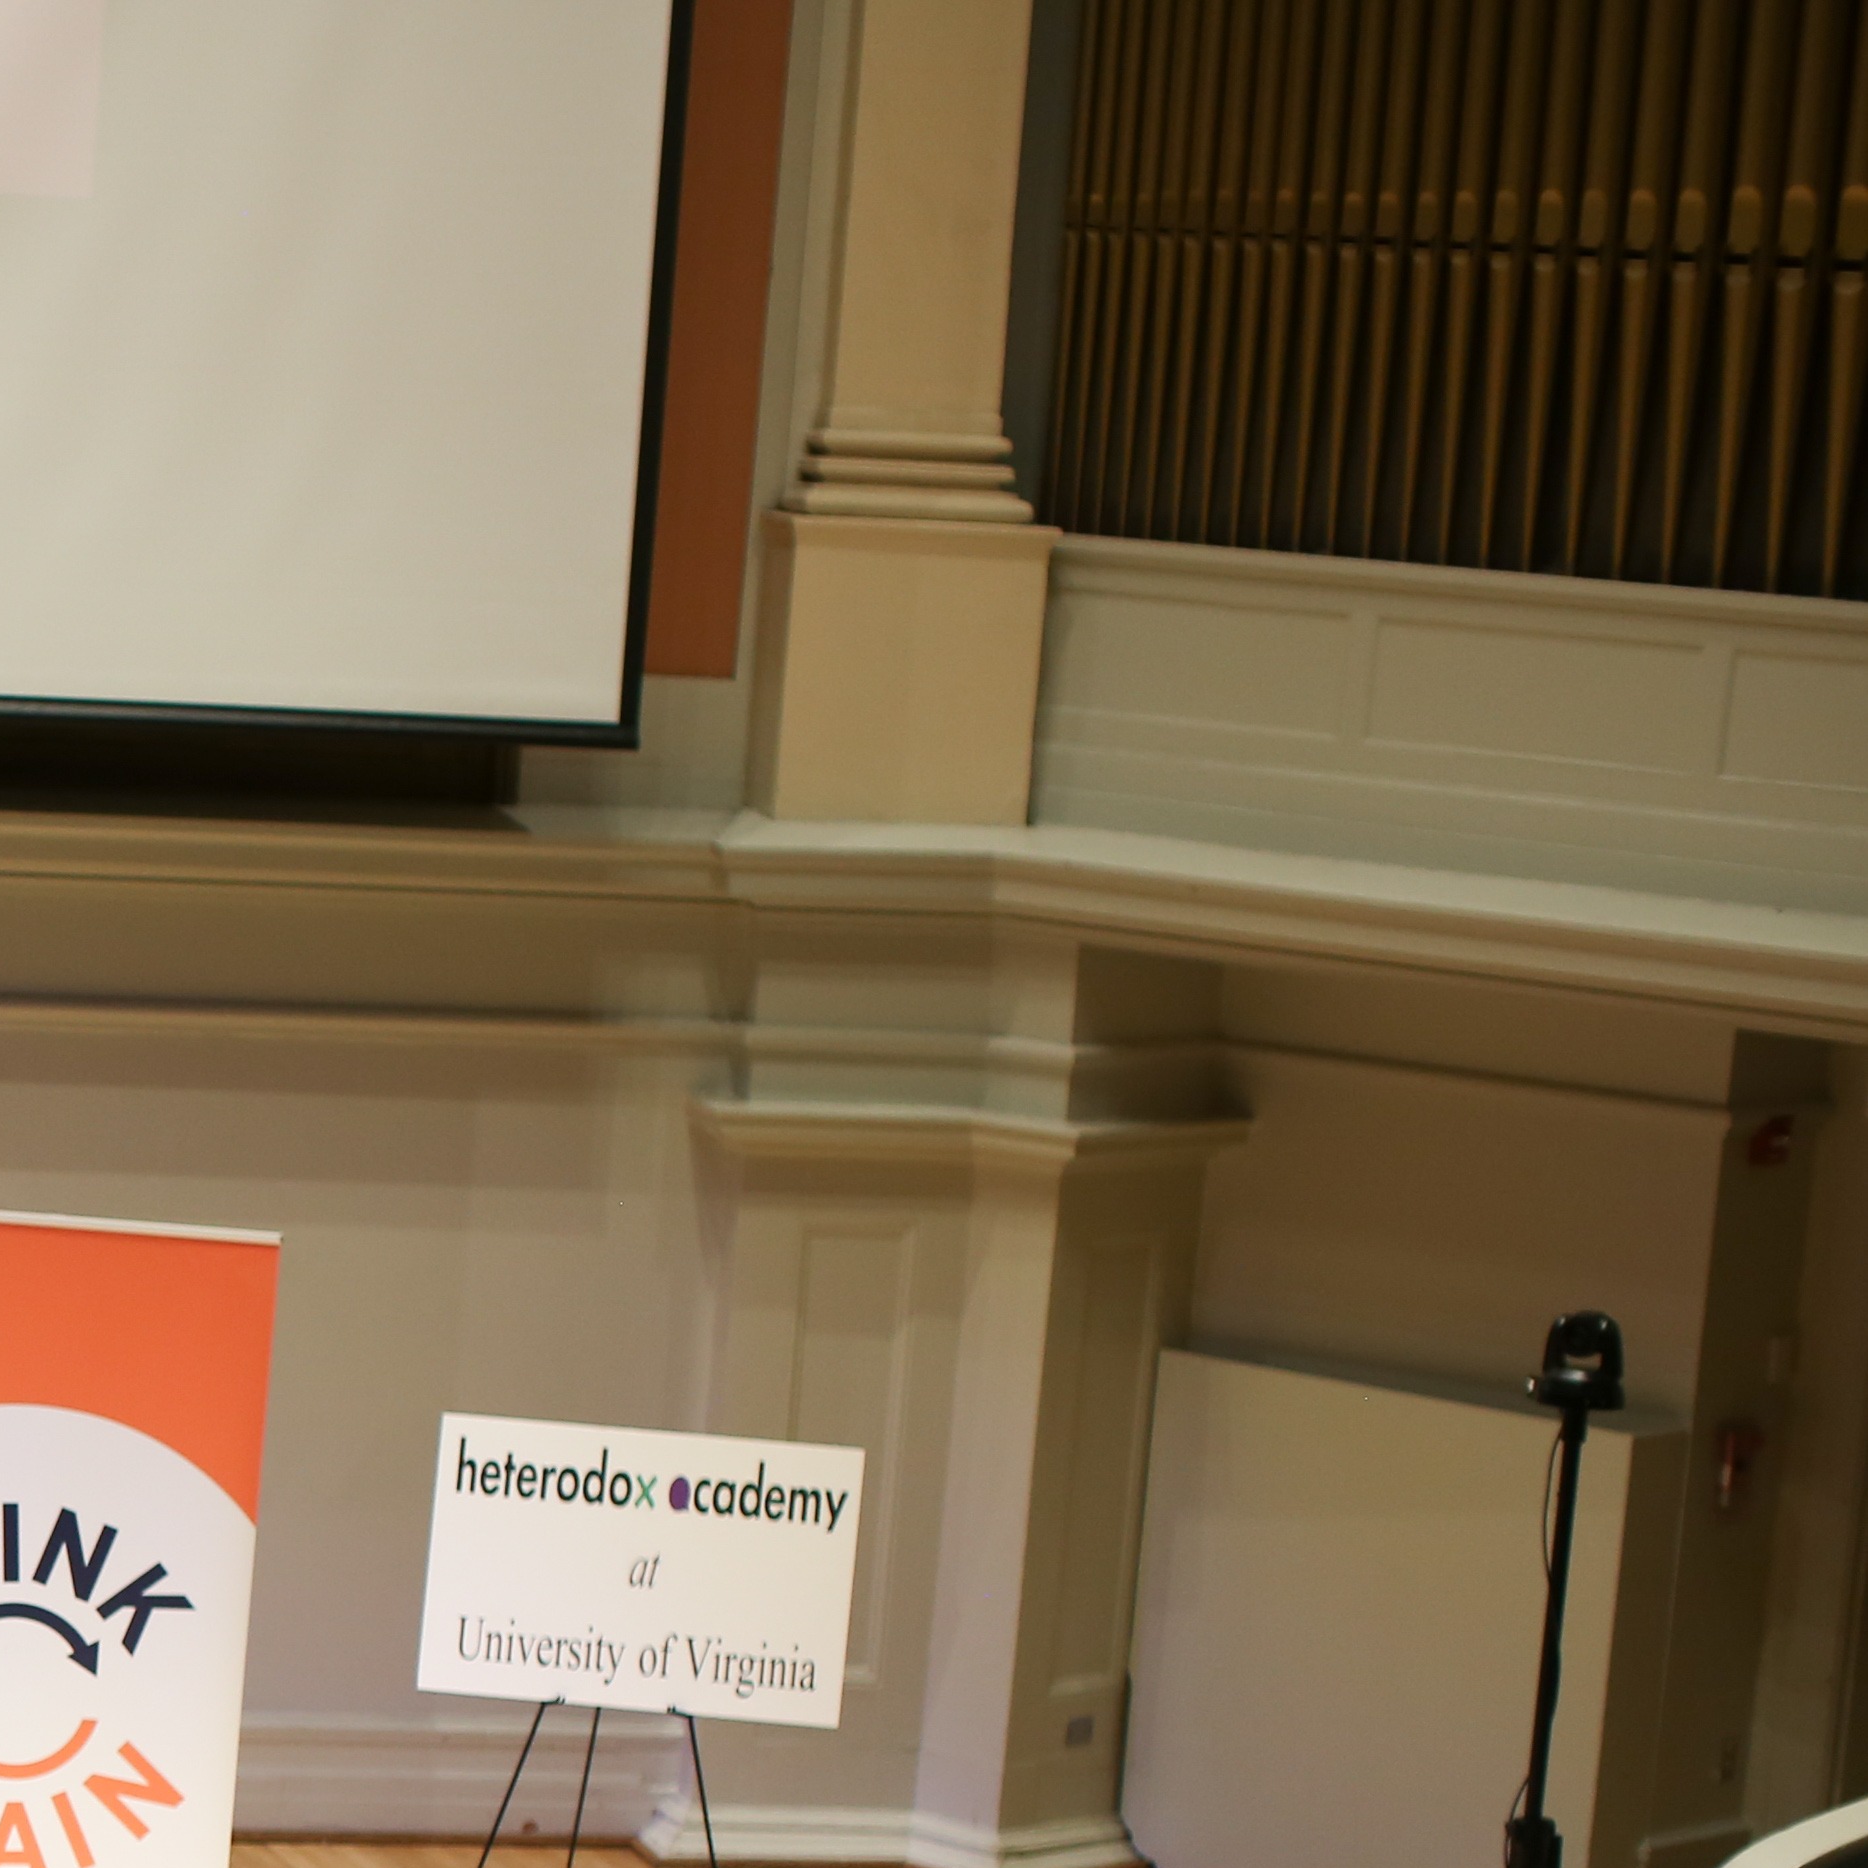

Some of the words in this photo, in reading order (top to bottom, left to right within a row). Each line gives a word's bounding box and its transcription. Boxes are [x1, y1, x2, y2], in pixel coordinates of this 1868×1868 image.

[455, 1437, 656, 1509] heterodox
[668, 1461, 848, 1533] academy
[628, 1552, 661, 1590] at
[457, 1616, 627, 1686] University
[639, 1632, 678, 1680] of
[688, 1636, 816, 1697] Virginia
